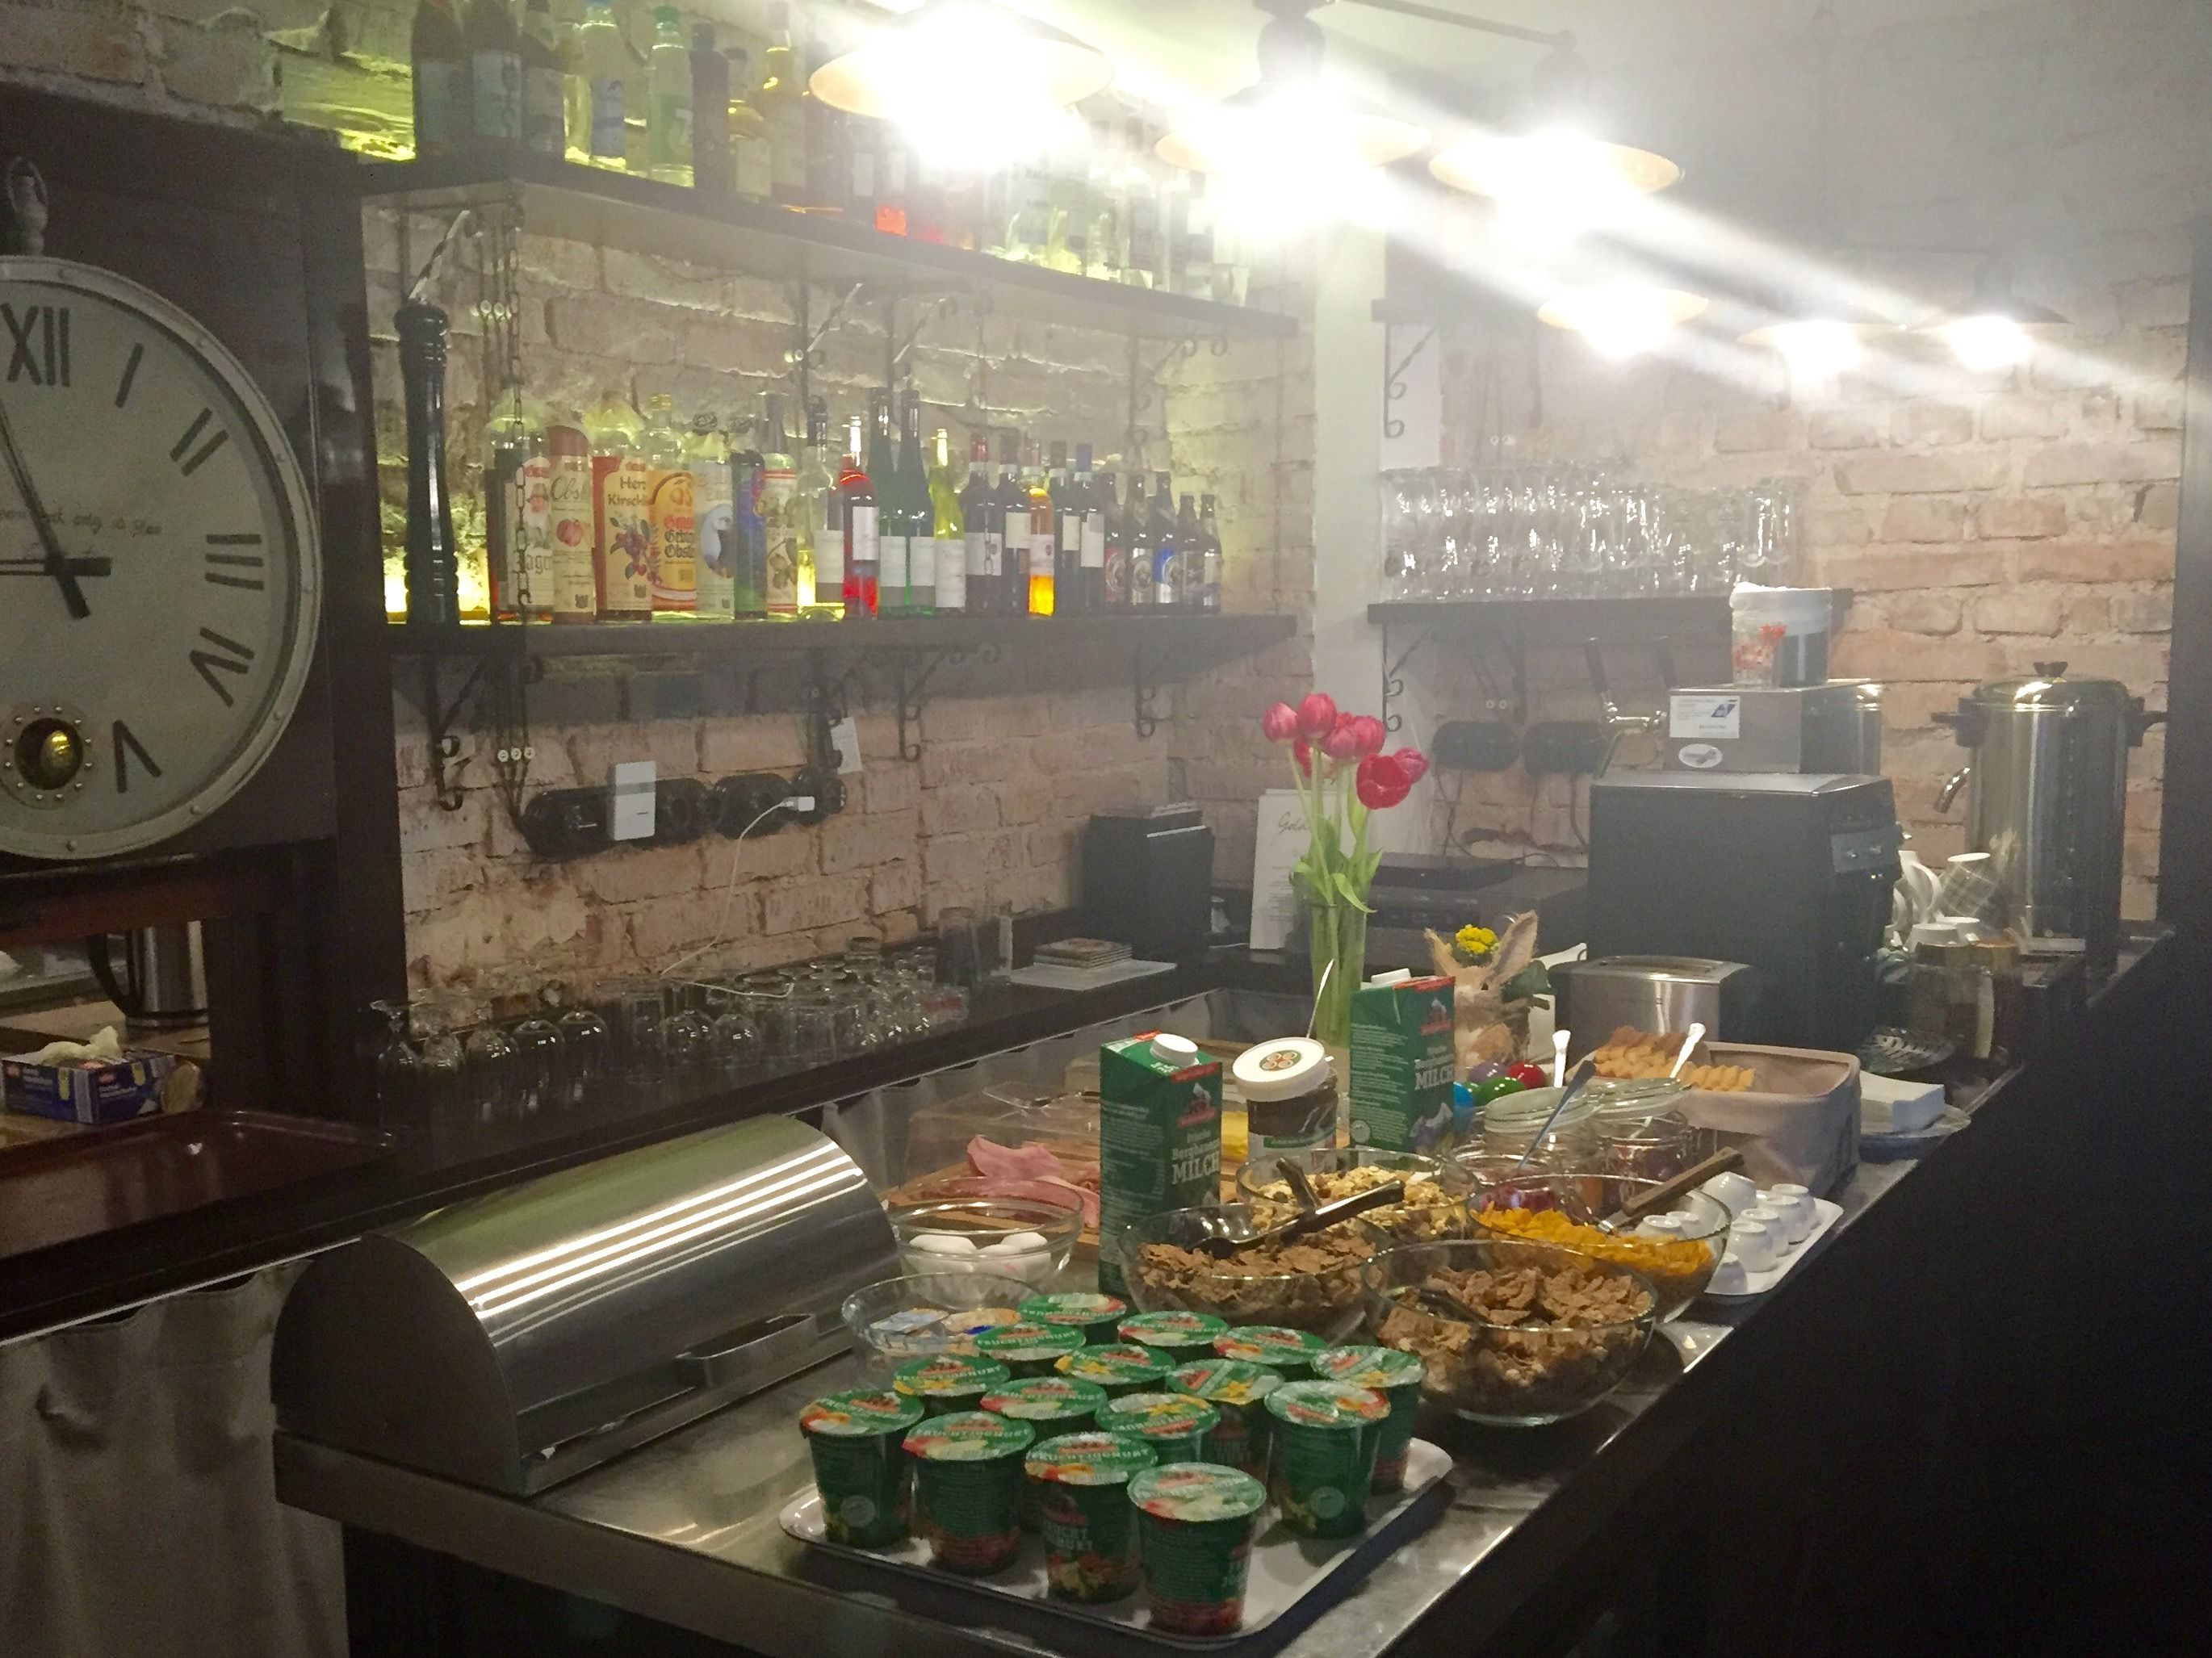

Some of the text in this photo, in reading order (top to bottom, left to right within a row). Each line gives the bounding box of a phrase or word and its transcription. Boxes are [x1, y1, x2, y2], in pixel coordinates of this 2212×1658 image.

[2, 304, 70, 387] XII
[115, 342, 144, 408] I
[170, 408, 229, 475] II
[204, 533, 265, 591] III
[189, 627, 255, 708] IV
[112, 718, 161, 793] V
[1171, 1150, 1221, 1185] MILCH
